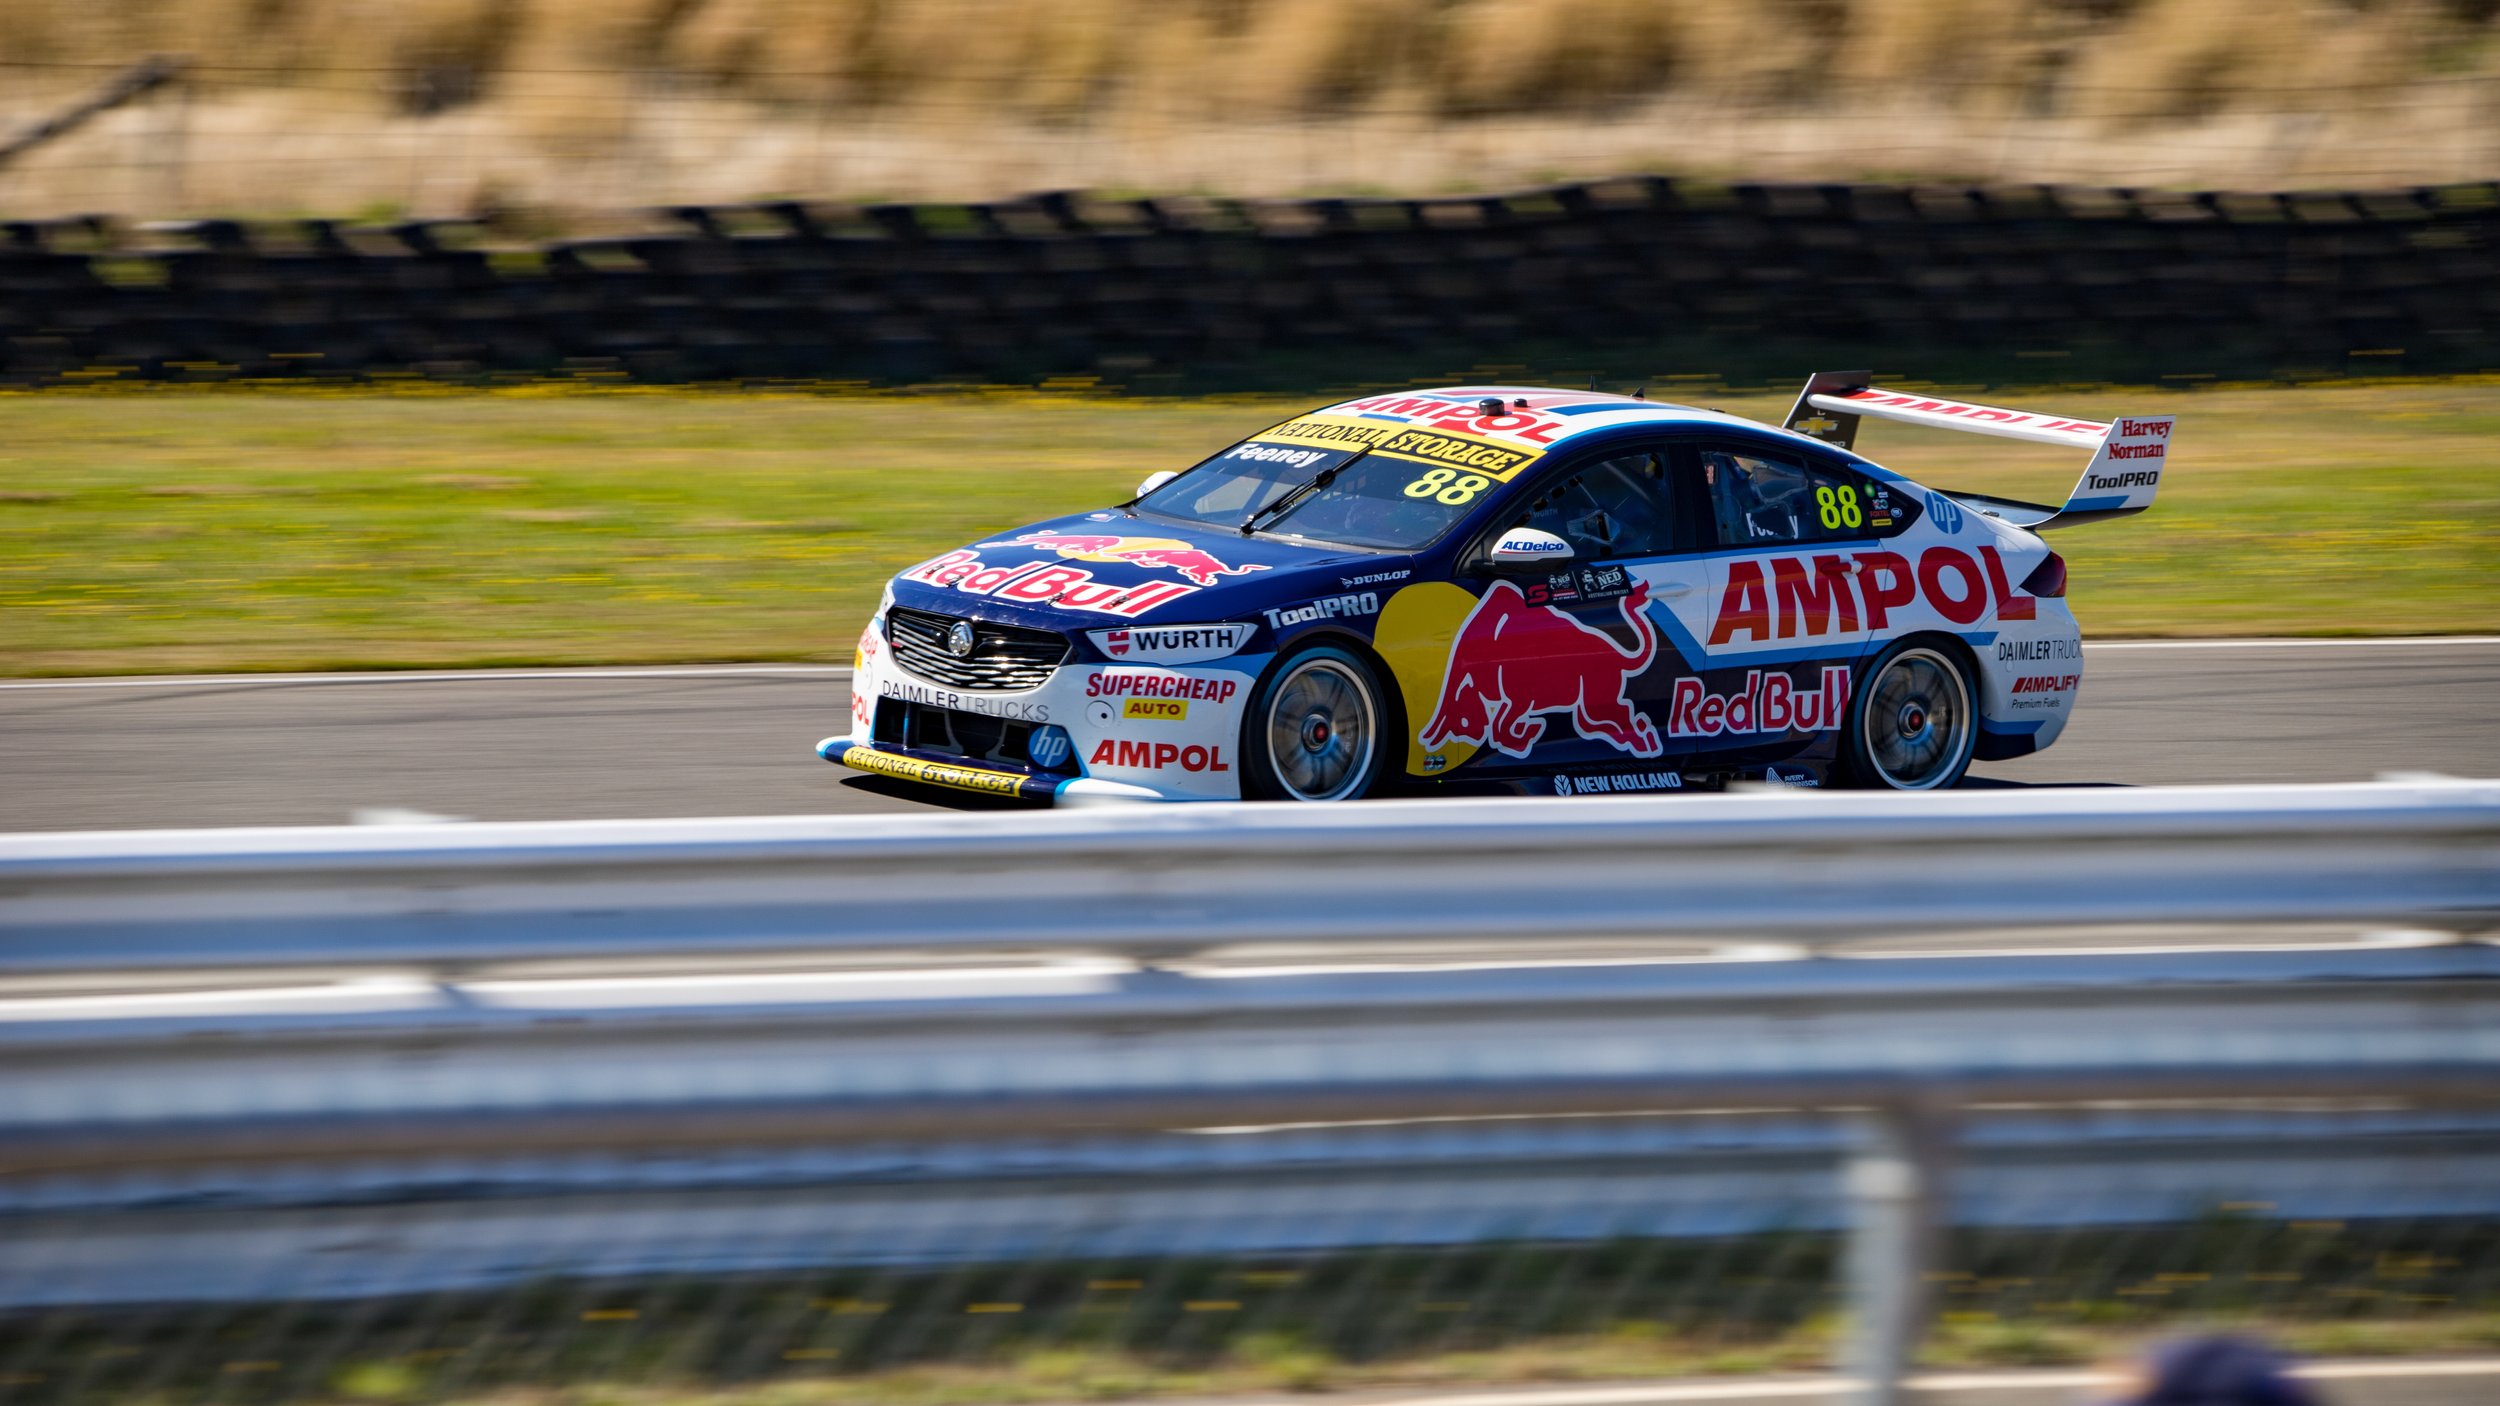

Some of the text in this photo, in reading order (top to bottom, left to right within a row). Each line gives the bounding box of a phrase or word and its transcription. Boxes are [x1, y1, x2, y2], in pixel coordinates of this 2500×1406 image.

[1334, 397, 1563, 444] AMPOL
[2120, 419, 2173, 439] Harvey
[1224, 443, 1328, 468] Feeney
[1268, 423, 1523, 470] NATIONAL STORAGE
[2107, 442, 2166, 461] Norman
[1404, 469, 1490, 505] 88
[2088, 471, 2159, 490] ToolPRO
[1816, 485, 1862, 529] 88
[1929, 491, 1957, 534] hp
[1501, 541, 1565, 551] ACDelco
[1352, 570, 1411, 586] DUNLOP
[1597, 571, 1623, 587] NED
[1706, 545, 2036, 646] AMPOL
[1262, 592, 1379, 630] ToolPRO
[1999, 640, 2051, 661] DAIMLER
[1086, 673, 1237, 704] SUPERCHEAP
[2022, 674, 2081, 693] AMPLIFY
[882, 680, 1050, 723] DAIMLER TRUCKS
[1128, 702, 1181, 716] AUTO
[2011, 697, 2061, 709] Premium Fuels
[1033, 725, 1067, 767] hp
[1090, 740, 1229, 772] AMPOL
[846, 750, 1016, 792] NATIONAL STORAGE
[1574, 771, 1682, 793] NEW HOLLAND
